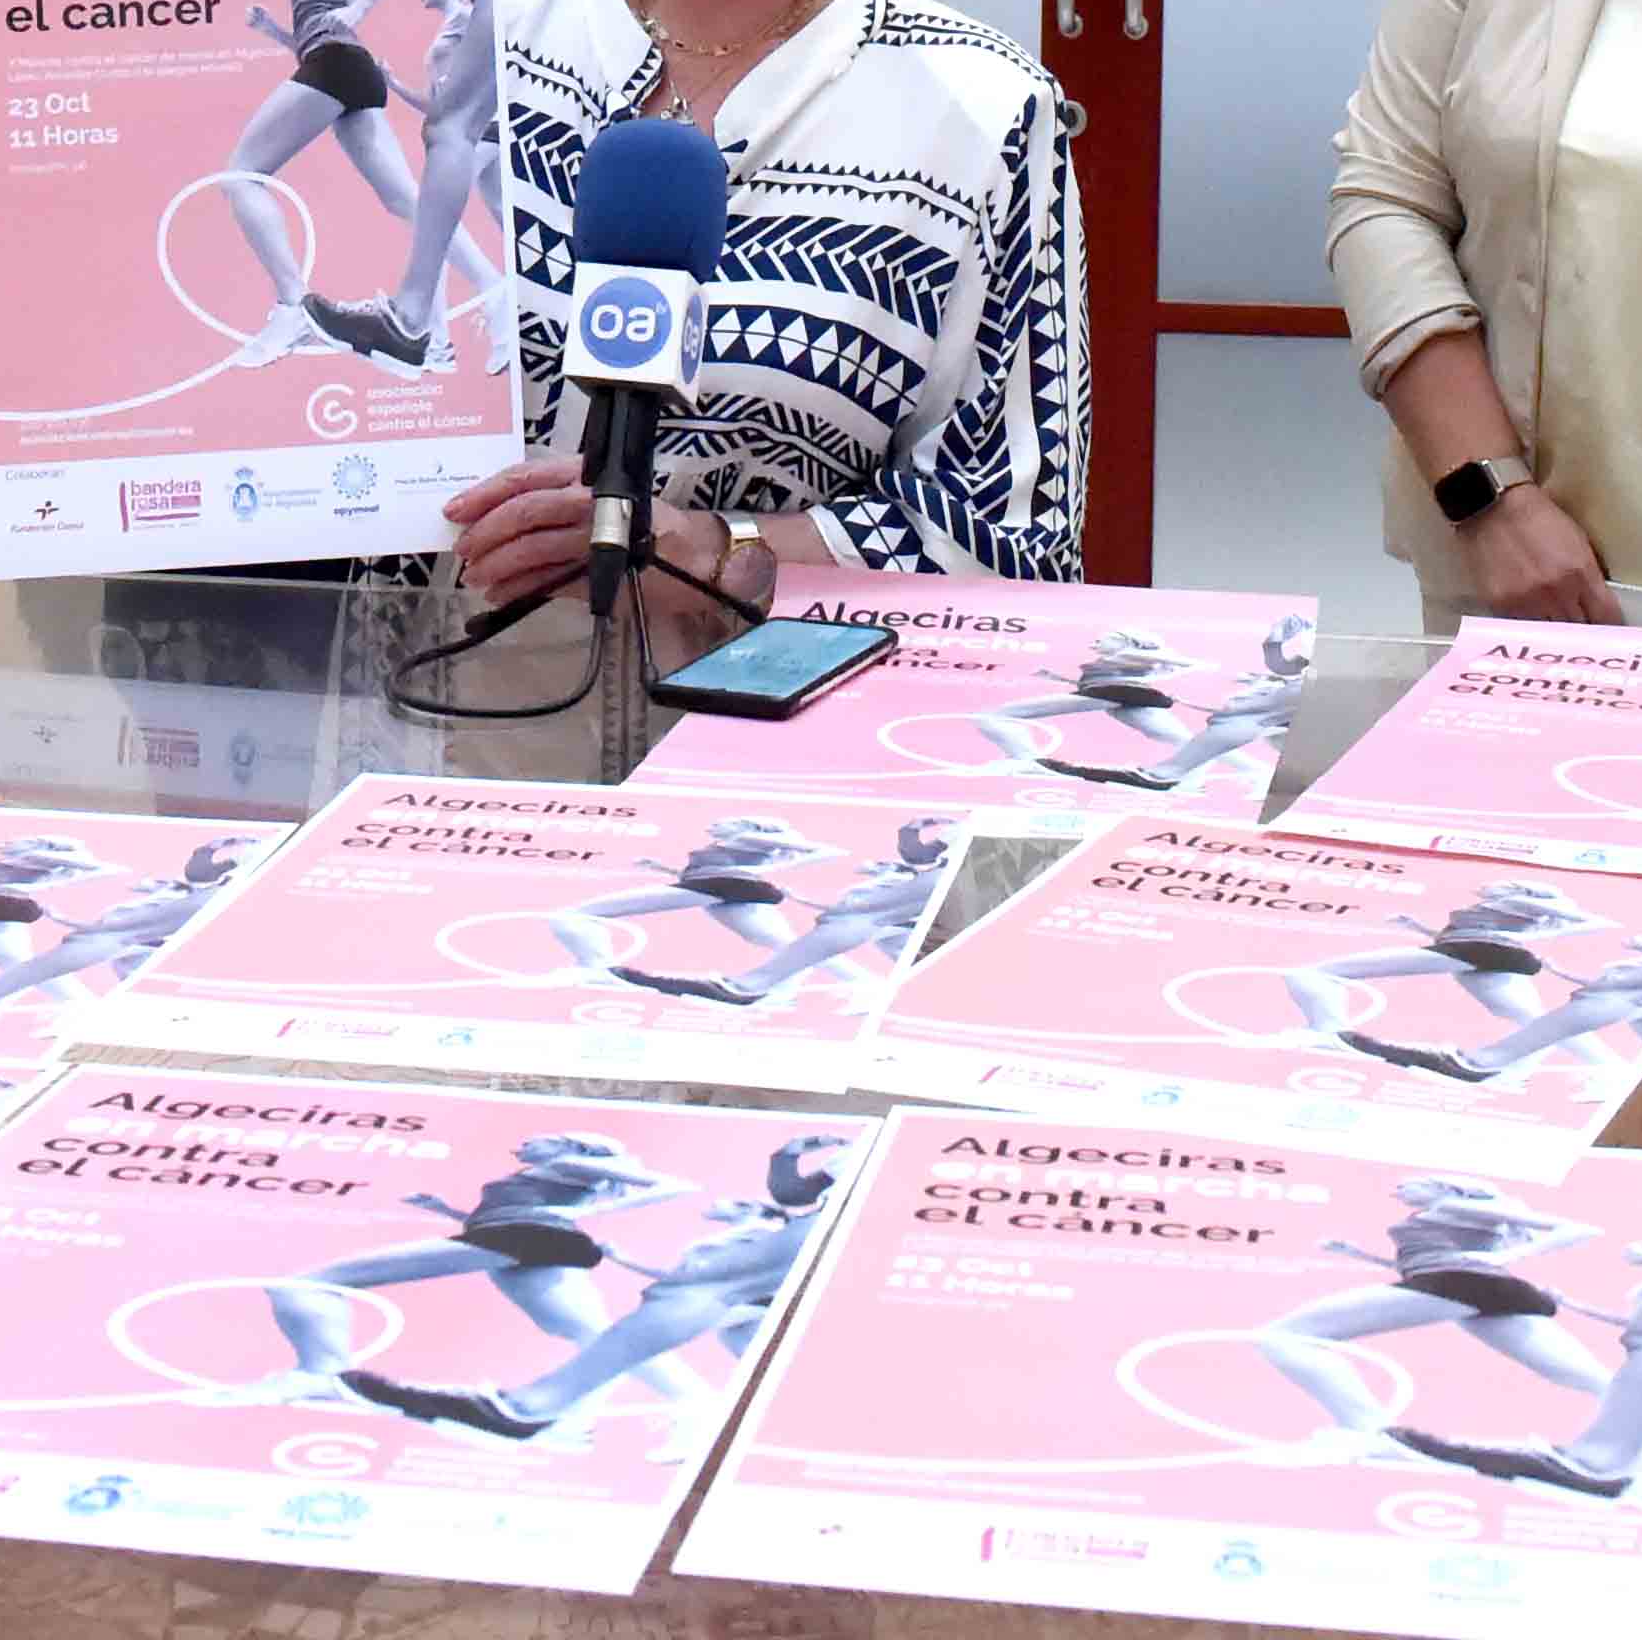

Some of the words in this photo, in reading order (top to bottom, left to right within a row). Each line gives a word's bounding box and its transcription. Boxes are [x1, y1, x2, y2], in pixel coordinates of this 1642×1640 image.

[8, 98, 38, 119] 23
[45, 91, 91, 114] Oct
[9, 129, 37, 148] 11
[44, 126, 118, 146] Horas
[590, 305, 656, 342] oa
[131, 479, 202, 497] bandera
[131, 496, 170, 511] rosa
[1459, 671, 1624, 697] contra
[383, 793, 638, 818] Algeciras
[341, 836, 392, 849] el
[357, 823, 533, 843] contra
[1144, 831, 1405, 875] Algeciras
[1091, 875, 1147, 892] el
[1110, 860, 1292, 894] contra
[88, 1091, 429, 1133] Algeciras
[43, 1137, 280, 1168] contra
[63, 1116, 163, 1139] en
[173, 1122, 452, 1160] marcha
[941, 1135, 1287, 1175] Algeciras
[17, 1156, 89, 1177] el
[108, 1163, 370, 1196] cáncer
[930, 1160, 1022, 1183] en
[1045, 1163, 1331, 1205] marcha
[924, 1183, 1168, 1215] contra
[914, 1204, 984, 1226] el
[1008, 1212, 1275, 1244] cáncer
